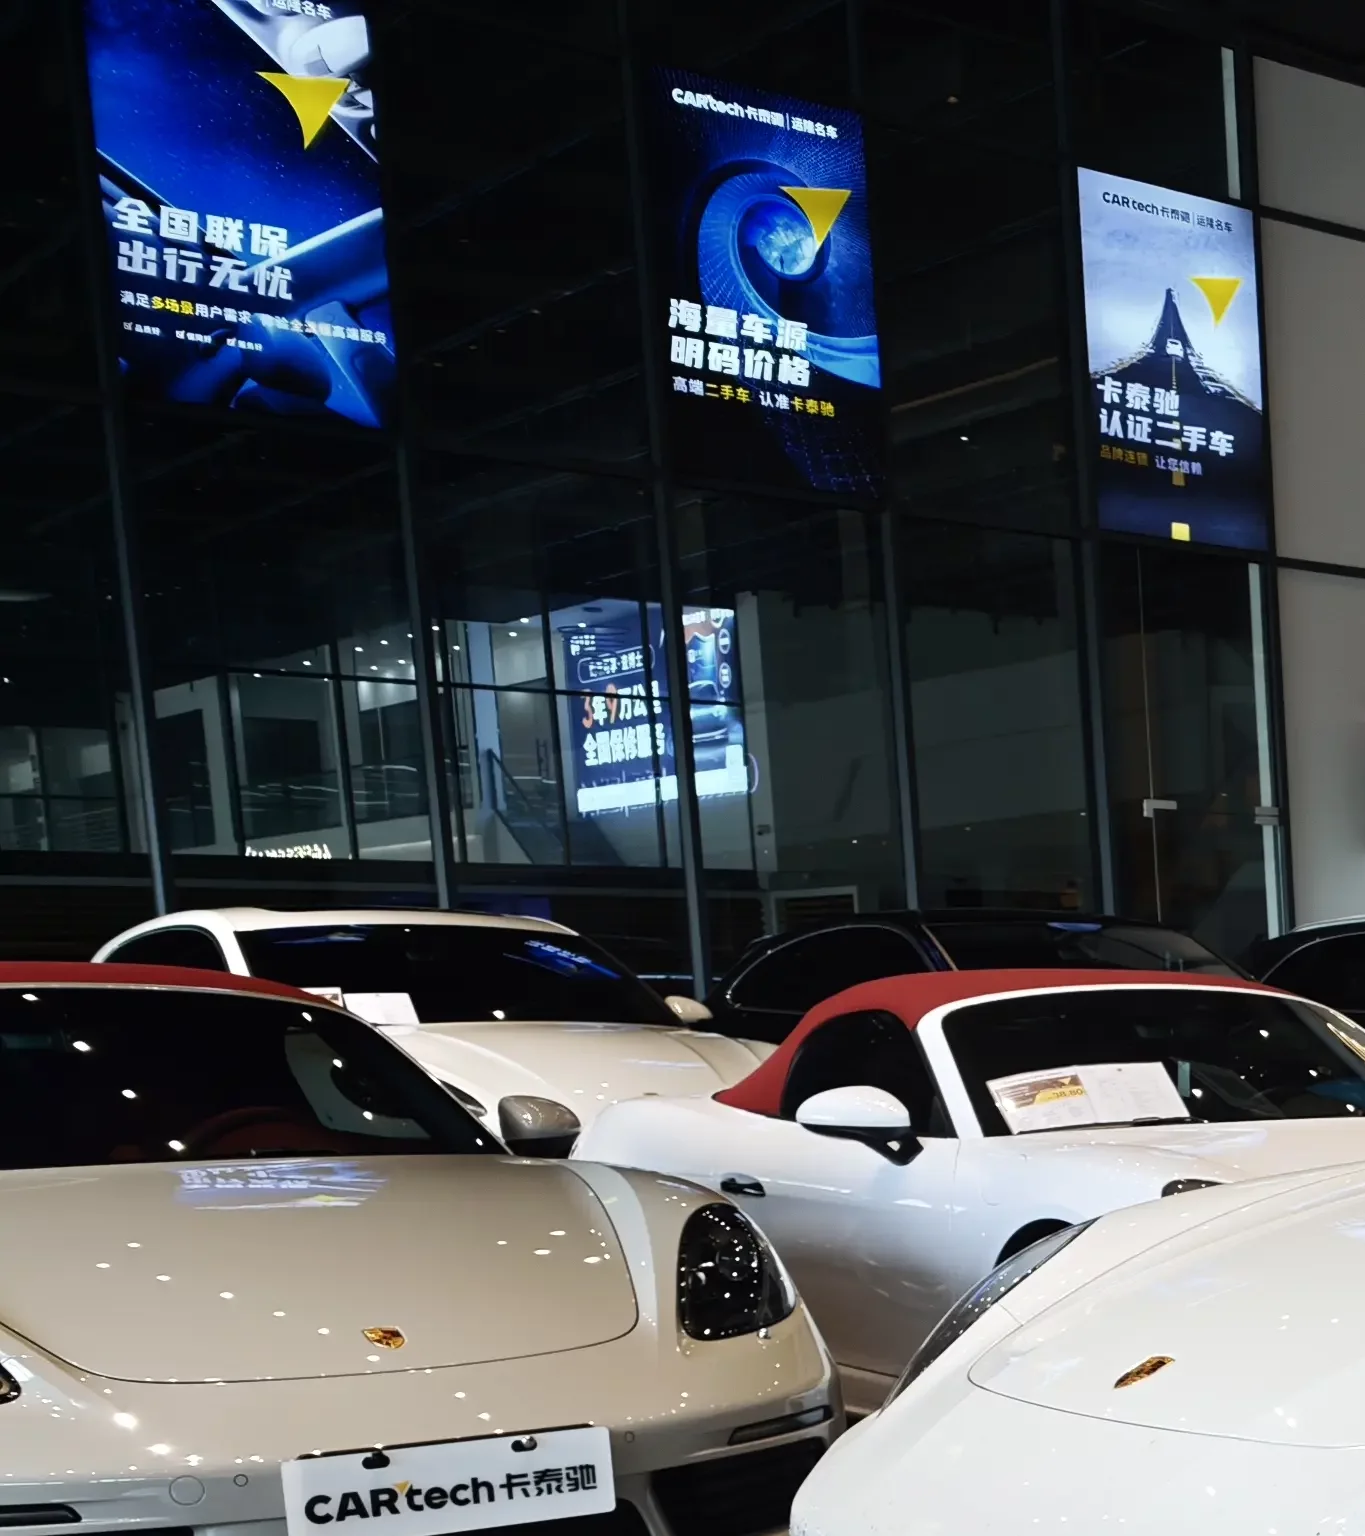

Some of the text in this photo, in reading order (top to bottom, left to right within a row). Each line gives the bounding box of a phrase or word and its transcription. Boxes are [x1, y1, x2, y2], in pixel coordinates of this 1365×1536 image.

[112, 197, 289, 258] 全国联保
[117, 240, 293, 300] 出行无忧
[668, 298, 808, 351] 海量车源
[670, 335, 810, 387] 明码价格
[672, 376, 836, 418] 高端二手车 认准卡泰驰
[1096, 376, 1180, 417] 卡泰驰
[1099, 408, 1235, 457] 认证二手车
[304, 1477, 496, 1525] CARtech
